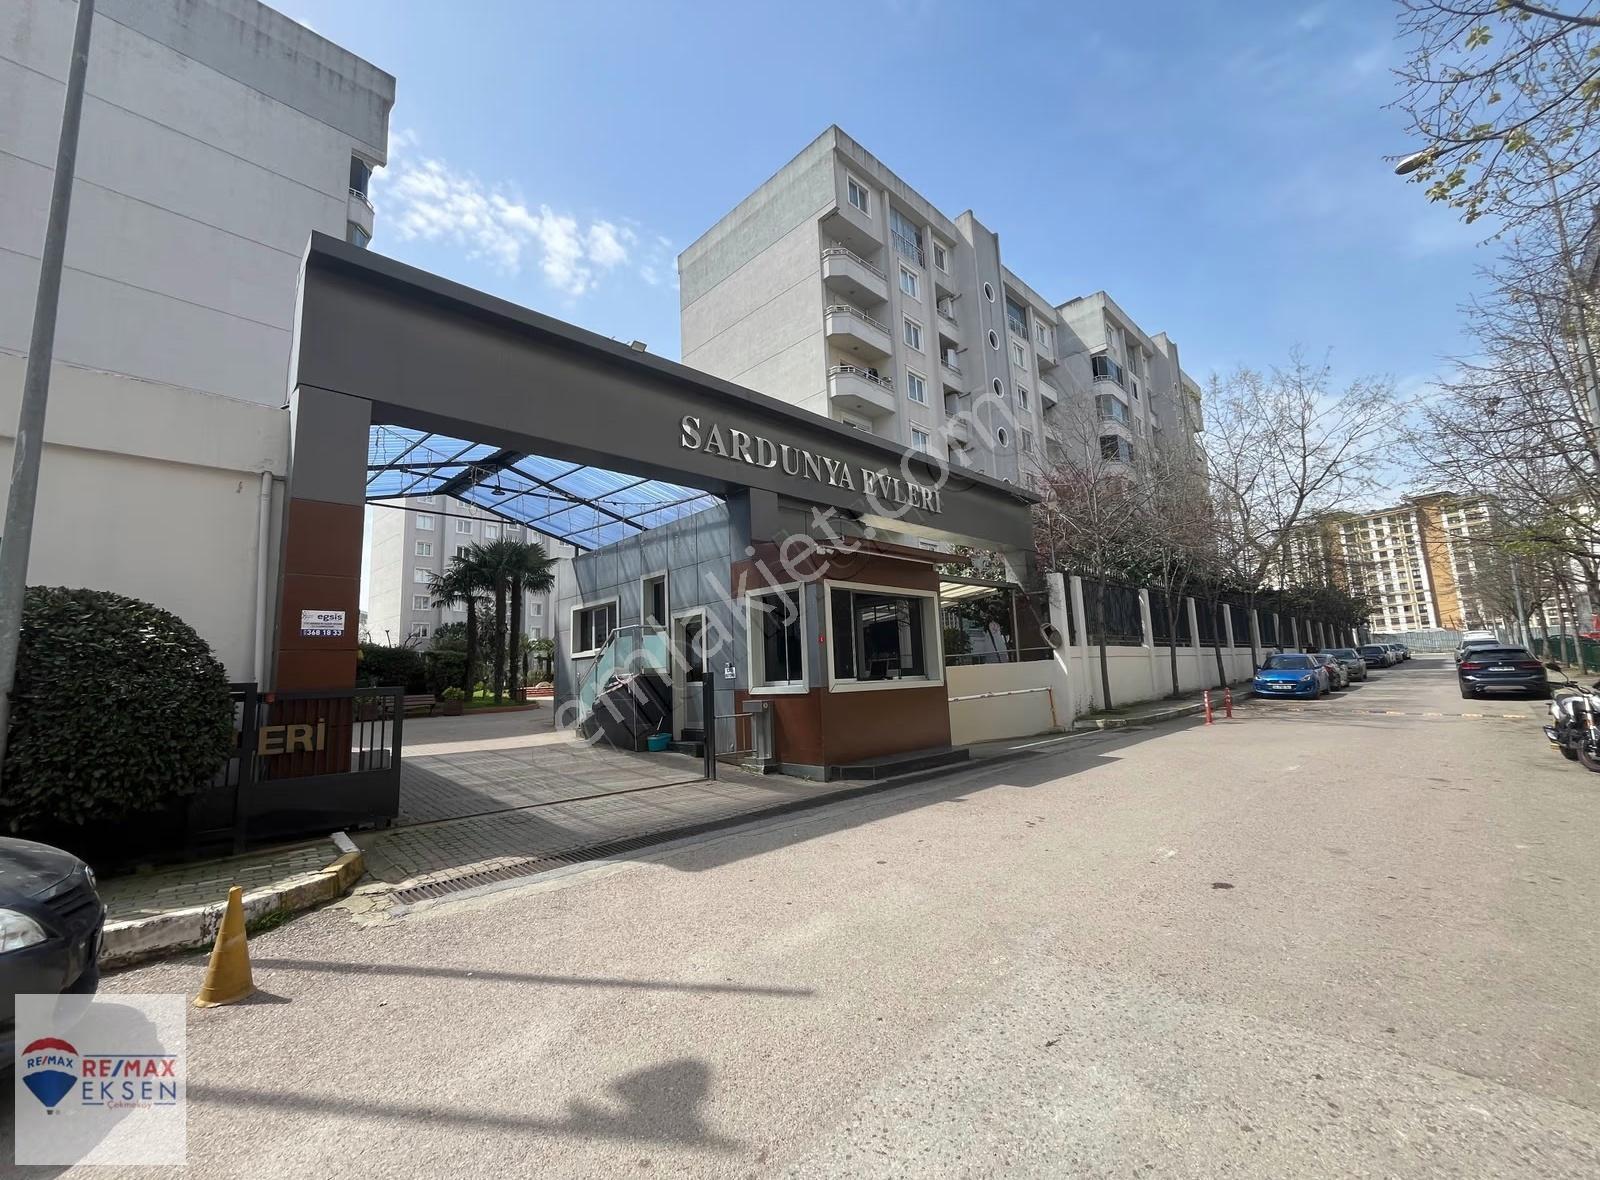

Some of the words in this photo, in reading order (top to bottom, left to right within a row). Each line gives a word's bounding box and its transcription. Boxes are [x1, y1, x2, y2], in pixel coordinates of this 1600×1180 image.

[681, 415, 856, 491] SARDUNYA
[317, 613, 343, 621] egsis
[258, 718, 326, 756] ERİ
